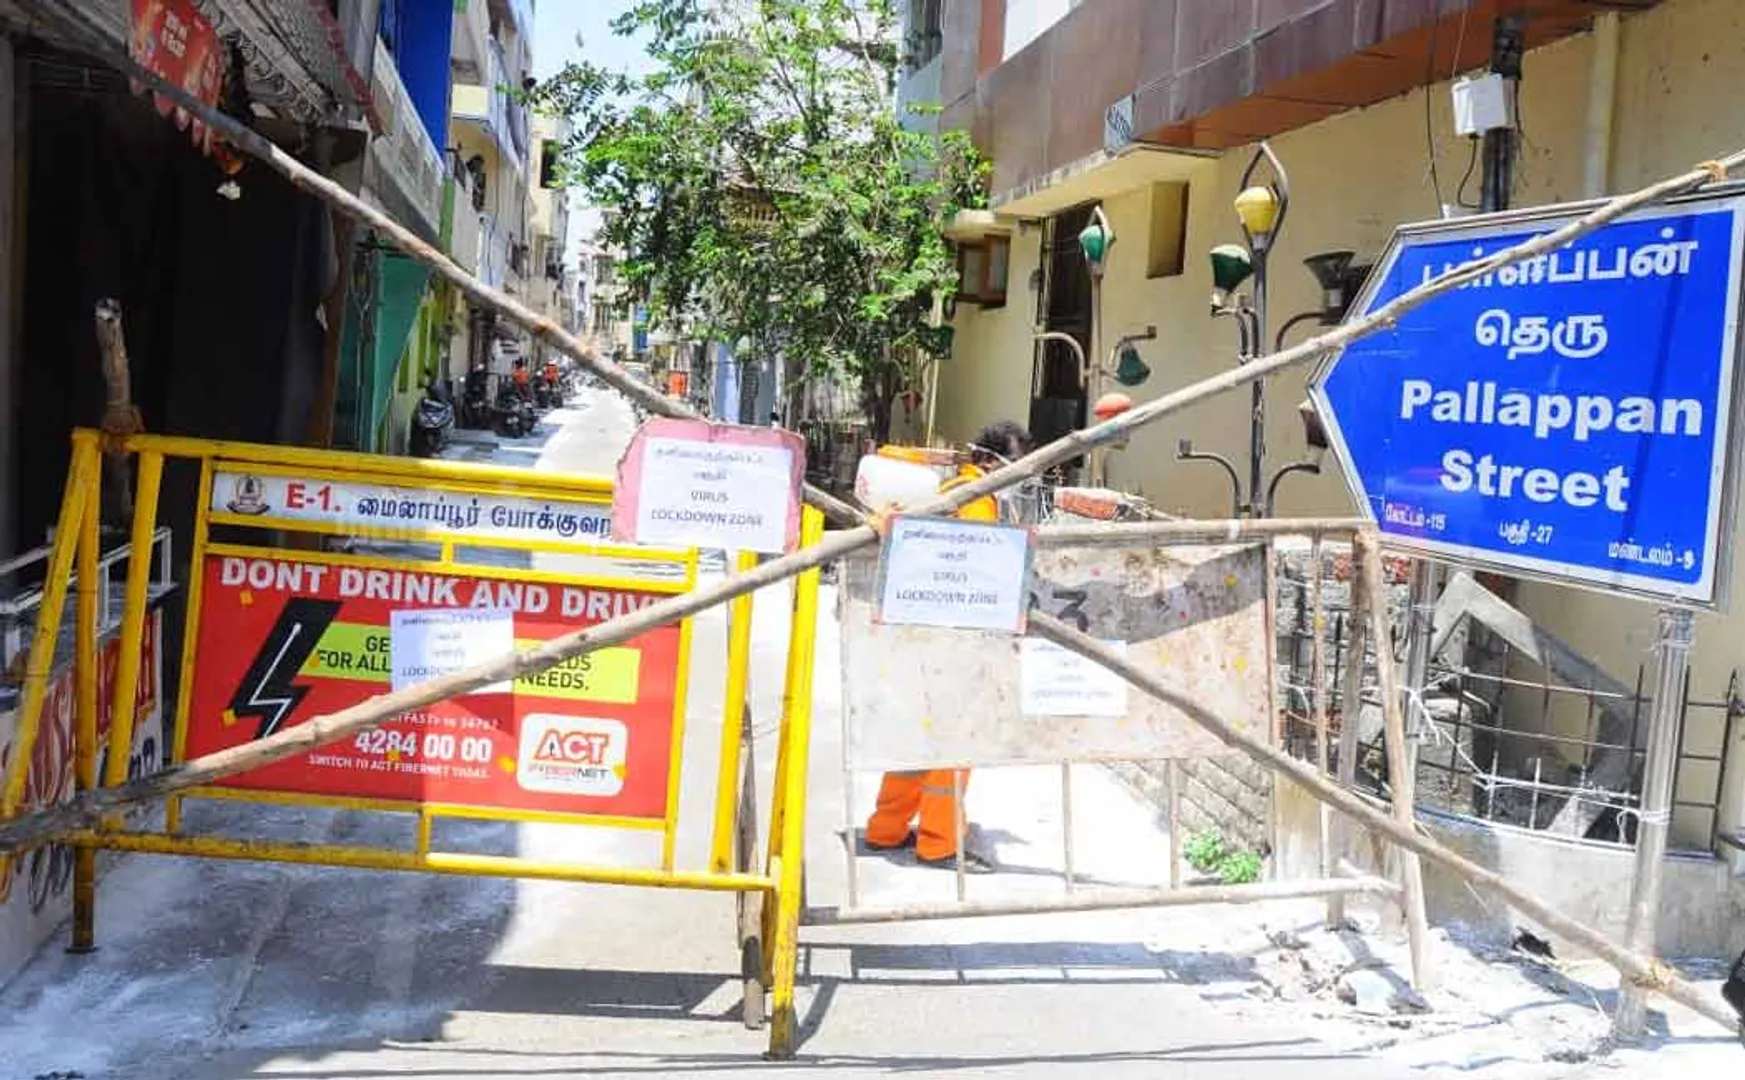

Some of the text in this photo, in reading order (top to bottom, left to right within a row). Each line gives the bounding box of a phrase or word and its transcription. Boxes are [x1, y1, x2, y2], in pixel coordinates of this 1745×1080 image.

[1475, 309, 1608, 360] தெரு
[1400, 379, 1703, 441] Pallappan
[284, 483, 342, 513] E-1.
[691, 490, 730, 504] VIRUS
[1440, 449, 1631, 513] Street
[651, 507, 727, 526] LOCKDOWN
[221, 557, 668, 620] DONT DRINK AND DRIV
[318, 649, 353, 669] FOR
[356, 653, 393, 674] ALL
[354, 729, 493, 763] 4284 00 00
[533, 728, 610, 765] ACT
